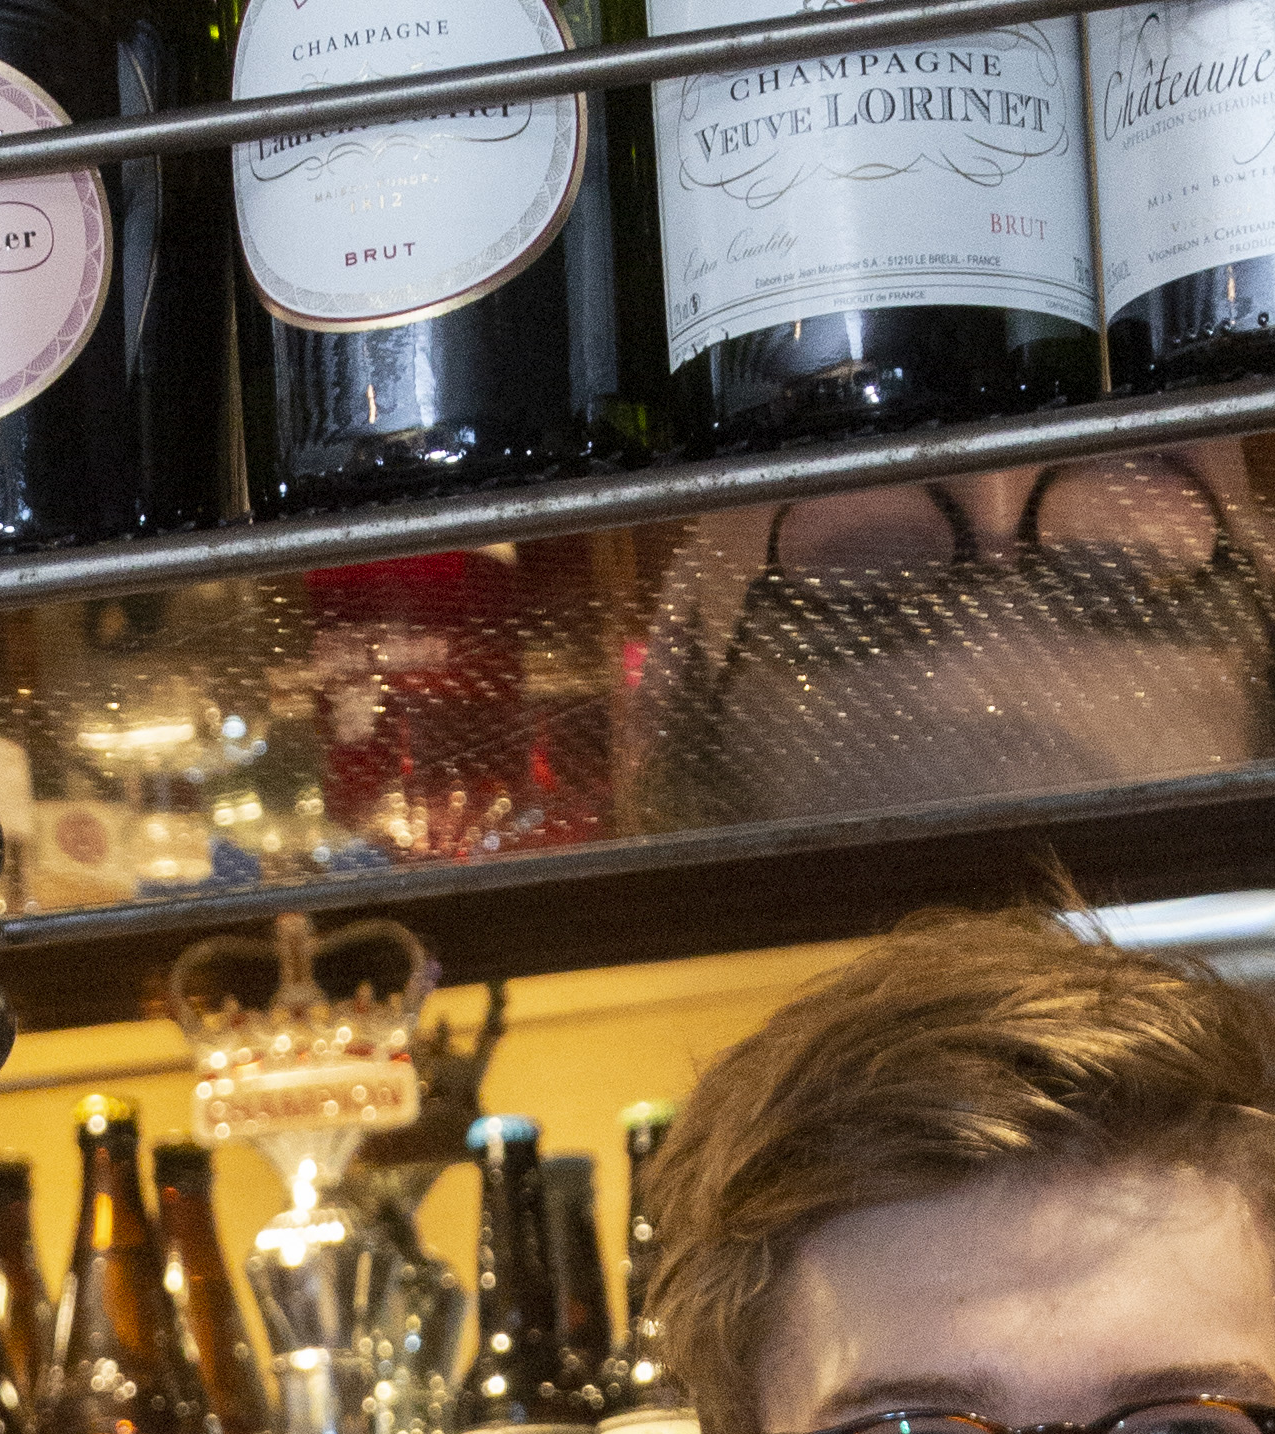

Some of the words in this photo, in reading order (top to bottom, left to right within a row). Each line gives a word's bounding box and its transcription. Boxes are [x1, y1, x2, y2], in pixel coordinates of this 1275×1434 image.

[292, 20, 449, 61] CHAMPAGNE
[730, 51, 1002, 101] CHAMPAGNE
[694, 107, 812, 163] VEUVE
[824, 85, 1050, 133] LORINET
[990, 213, 1048, 241] BRUT
[345, 242, 415, 267] BRUT
[967, 255, 1001, 267] FRANCE
